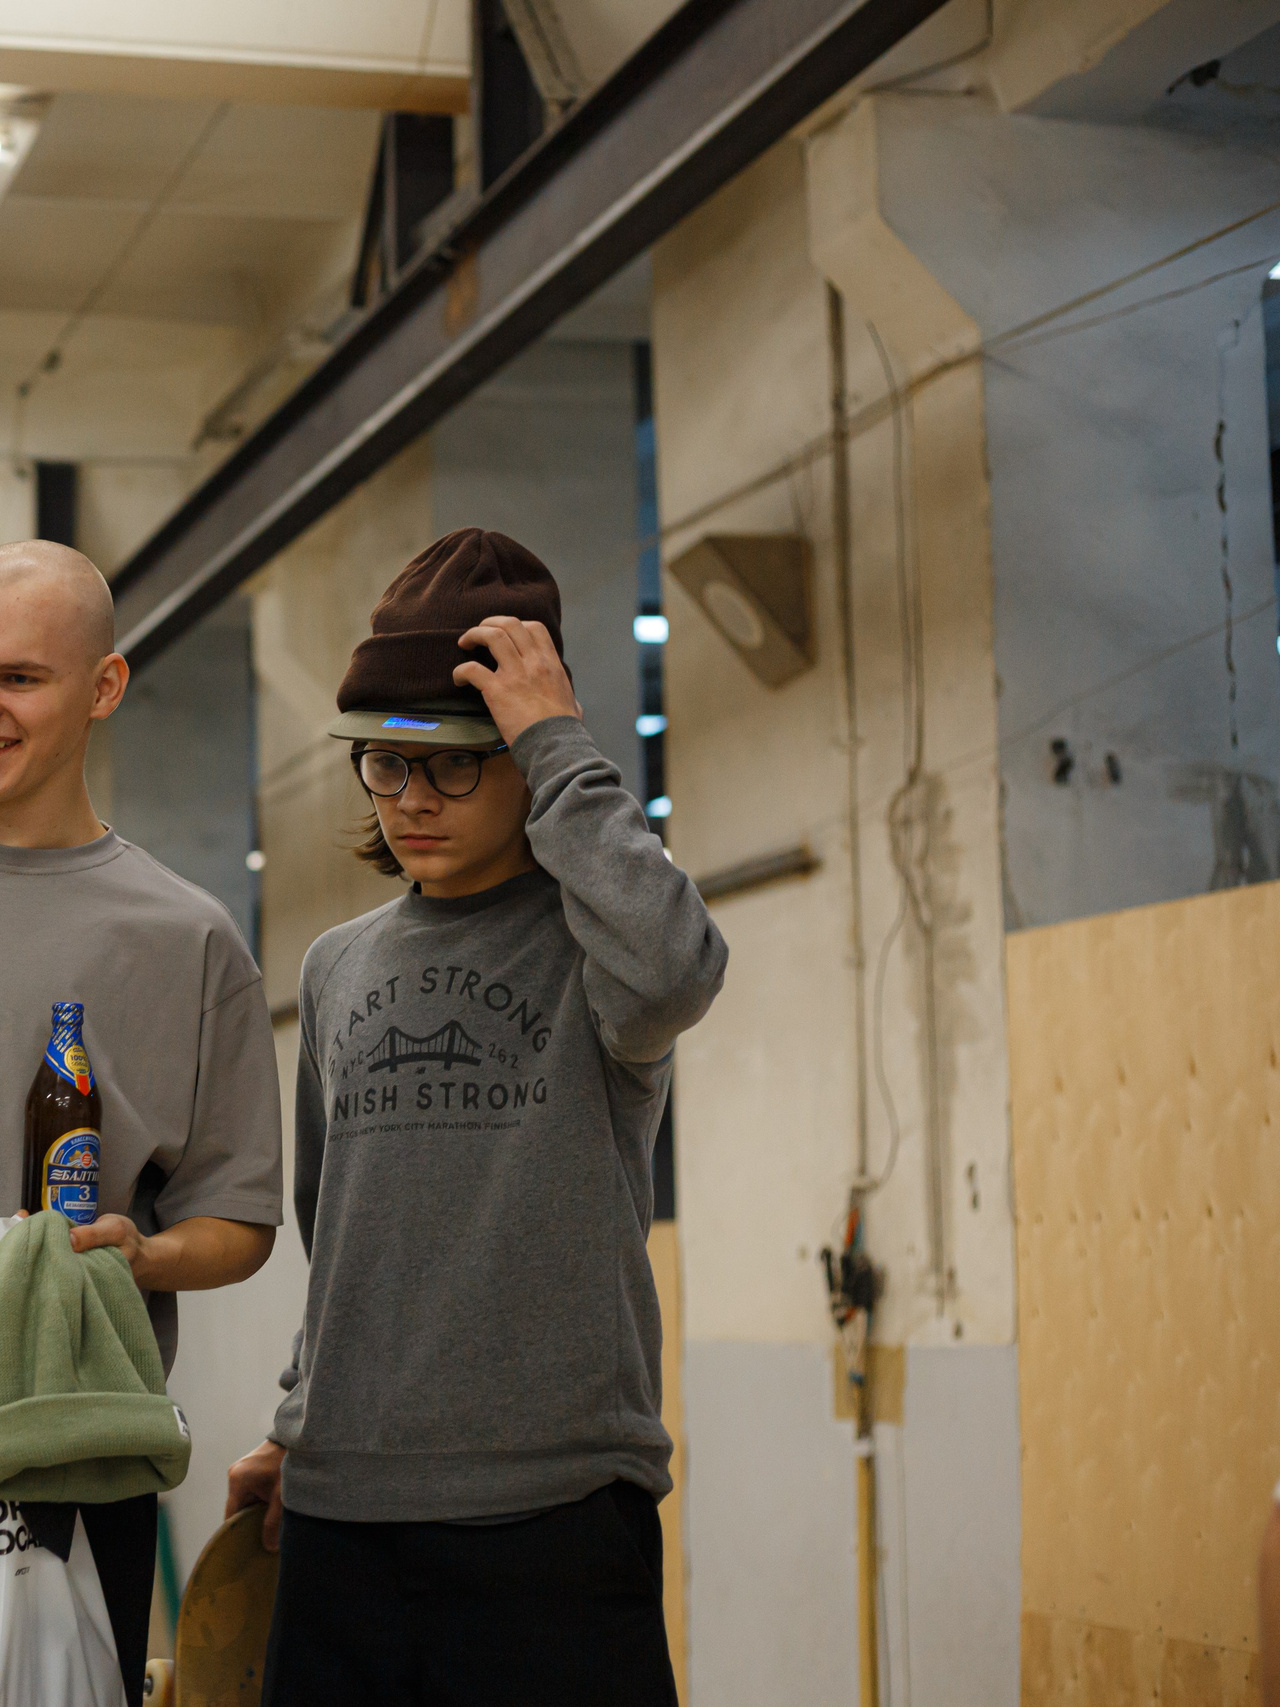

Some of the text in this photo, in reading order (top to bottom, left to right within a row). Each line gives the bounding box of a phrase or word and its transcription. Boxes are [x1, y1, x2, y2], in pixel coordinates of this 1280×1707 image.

[419, 965, 552, 1054] STRONG
[341, 1050, 364, 1080] NYC
[333, 1077, 547, 1122] NISH STRONG
[379, 1123, 403, 1133] YORK
[404, 1122, 424, 1132] CITY
[427, 1121, 481, 1131] MARATHON
[79, 1184, 91, 1201] 3
